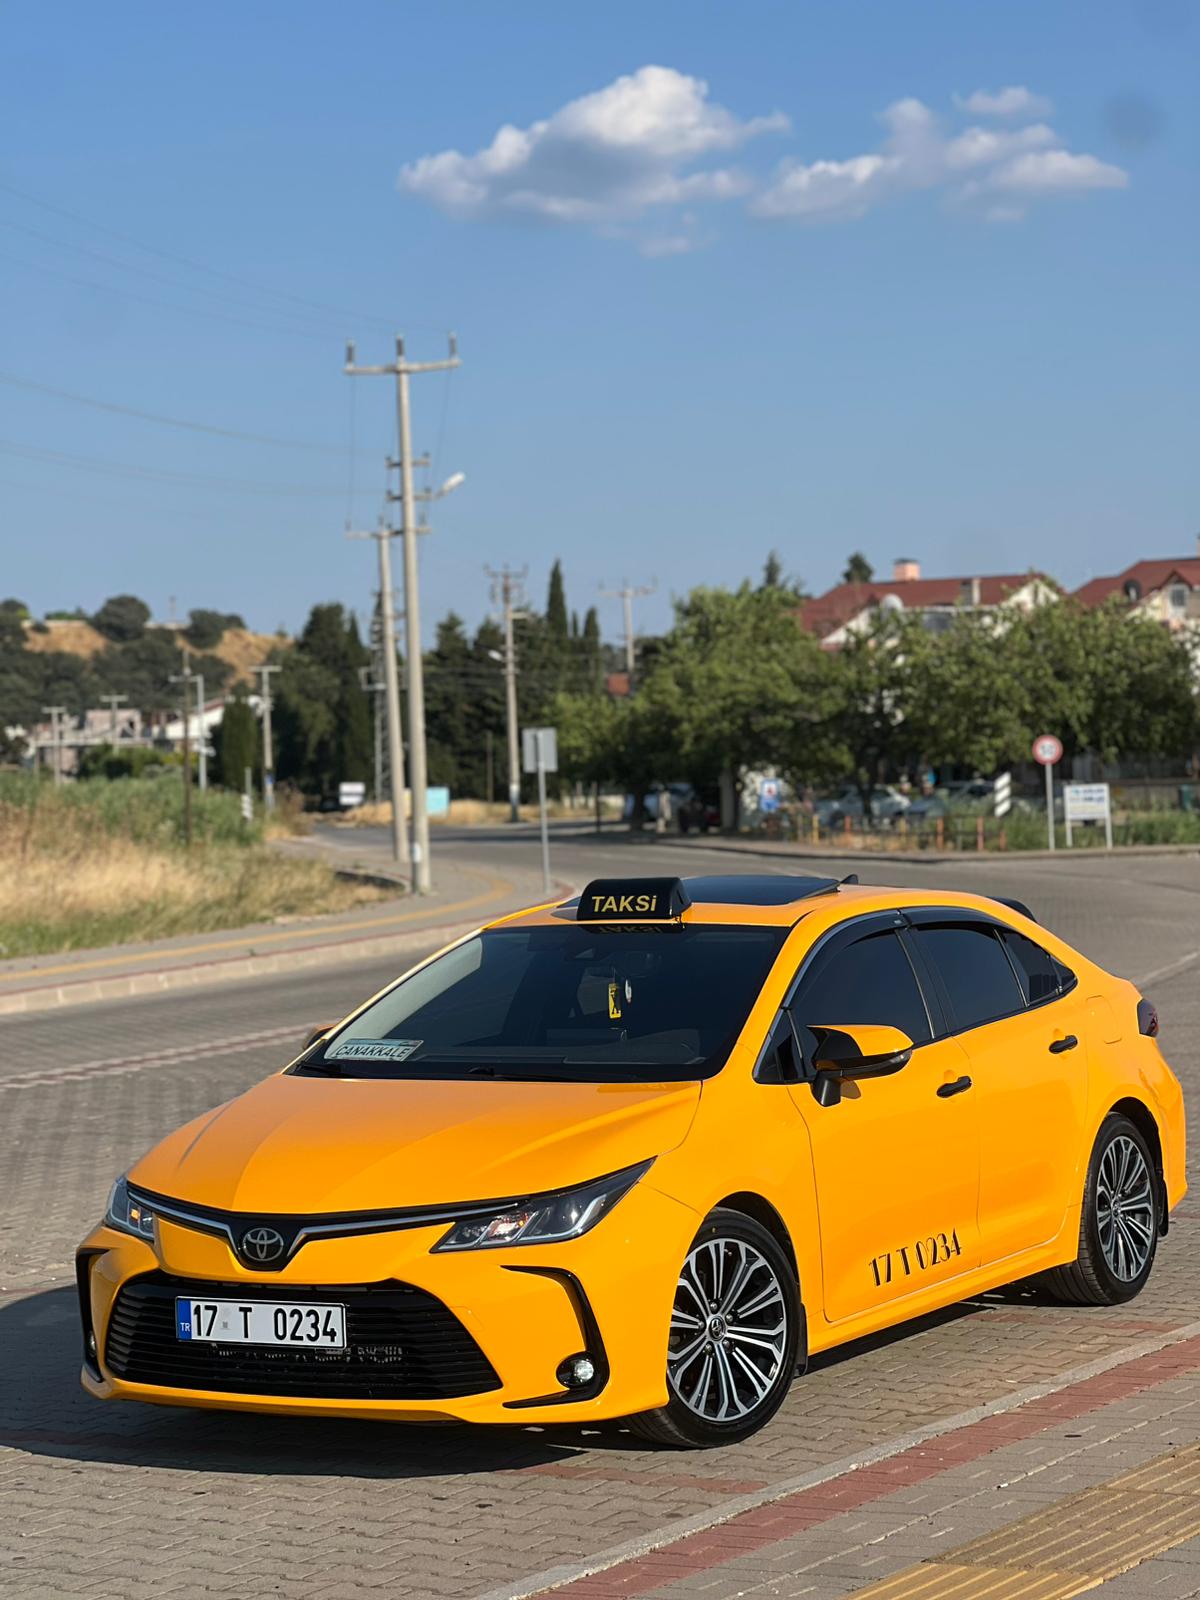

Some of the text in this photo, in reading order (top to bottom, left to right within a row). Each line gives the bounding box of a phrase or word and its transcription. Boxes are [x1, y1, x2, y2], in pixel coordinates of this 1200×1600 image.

[868, 1228, 962, 1287] 17 T 0234
[180, 1322, 191, 1332] TR
[193, 1304, 338, 1343] 17 T 0234
